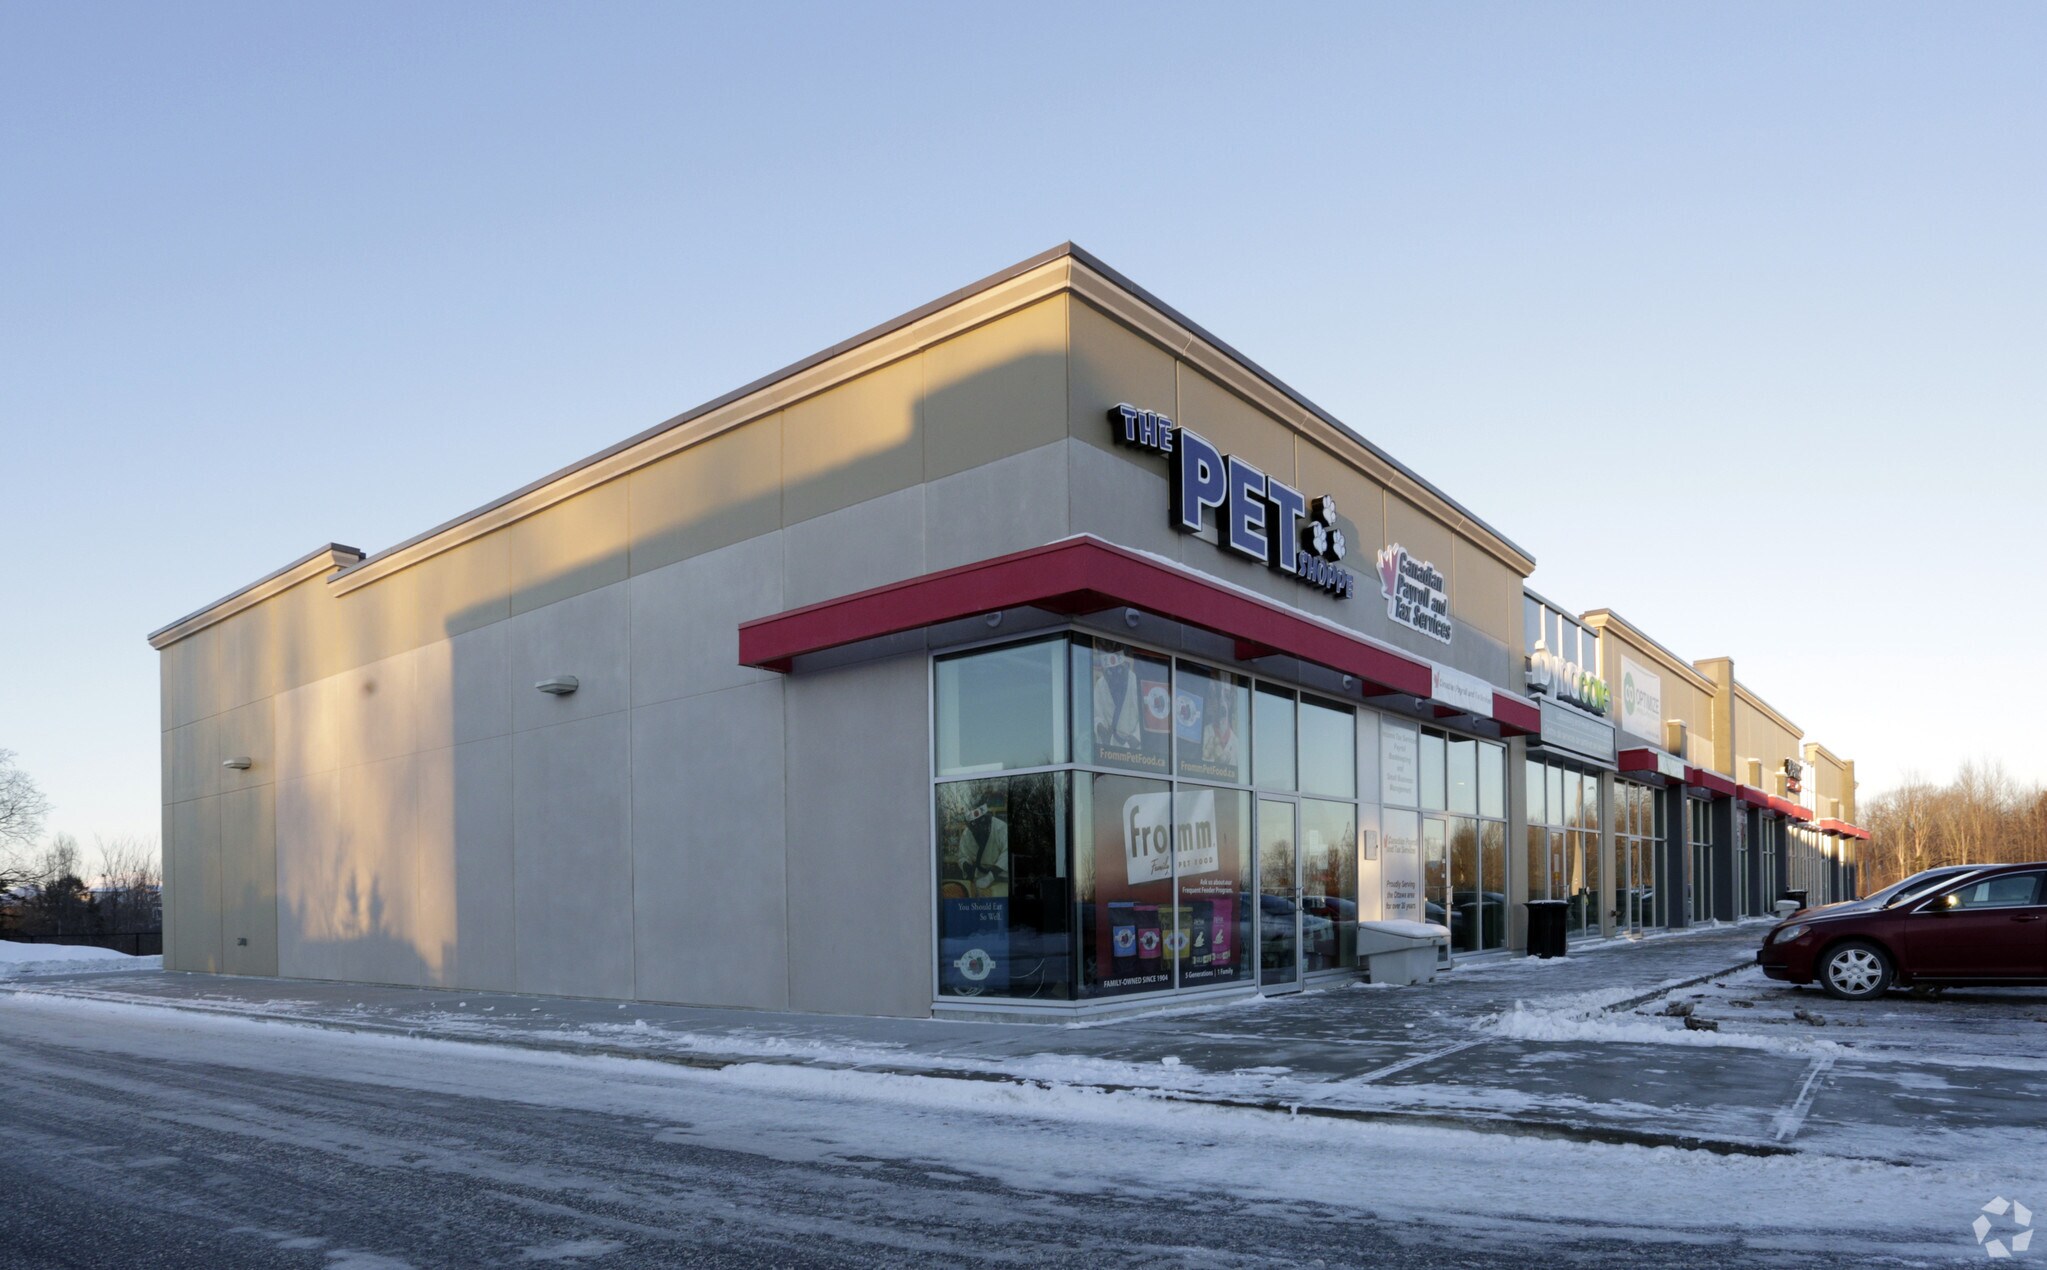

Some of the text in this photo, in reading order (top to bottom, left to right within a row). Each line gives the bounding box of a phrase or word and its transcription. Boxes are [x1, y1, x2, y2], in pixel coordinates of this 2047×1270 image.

[1119, 404, 1173, 453] THE
[1181, 427, 1306, 574] PET
[1298, 550, 1353, 600] SHOPPE
[1399, 552, 1443, 593] Canadian
[1396, 573, 1447, 617] Payroll and
[1395, 596, 1451, 640] Tax Services
[1635, 688, 1660, 715] OPTIMIZE
[1100, 748, 1165, 767] FrommPetFood.ca
[1180, 760, 1236, 778] FrommPetFood.ca
[1130, 805, 1212, 858] fromm
[1386, 879, 1416, 889] Proudly Serving
[958, 902, 1002, 911] You Should Eat
[1103, 974, 1168, 988] FAMILY-OWNED SINCE 1904
[1188, 970, 1214, 978] Generations
[1220, 967, 1234, 975] Family
